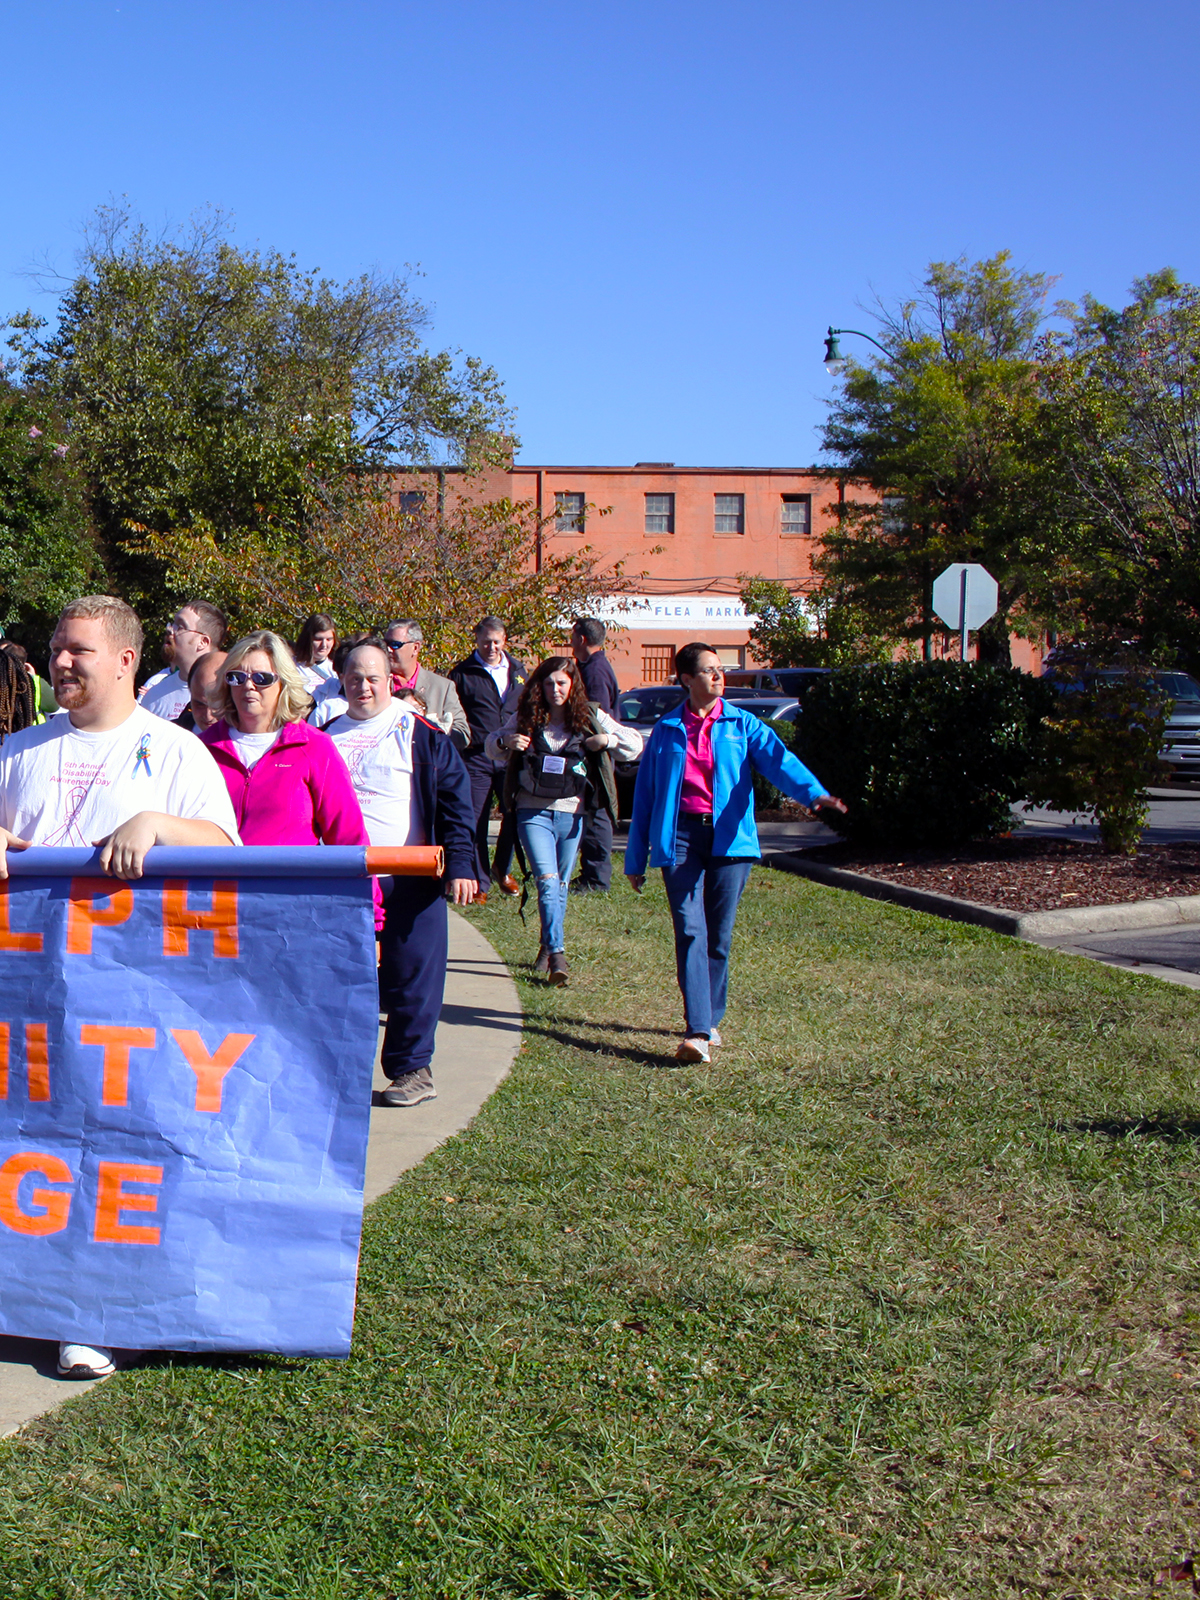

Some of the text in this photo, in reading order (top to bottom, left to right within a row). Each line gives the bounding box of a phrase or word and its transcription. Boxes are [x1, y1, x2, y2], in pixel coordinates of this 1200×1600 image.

[655, 607, 690, 616] FLEA
[705, 607, 755, 616] MARK
[62, 768, 106, 778] Disabilits
[50, 775, 111, 787] Awarenes Day
